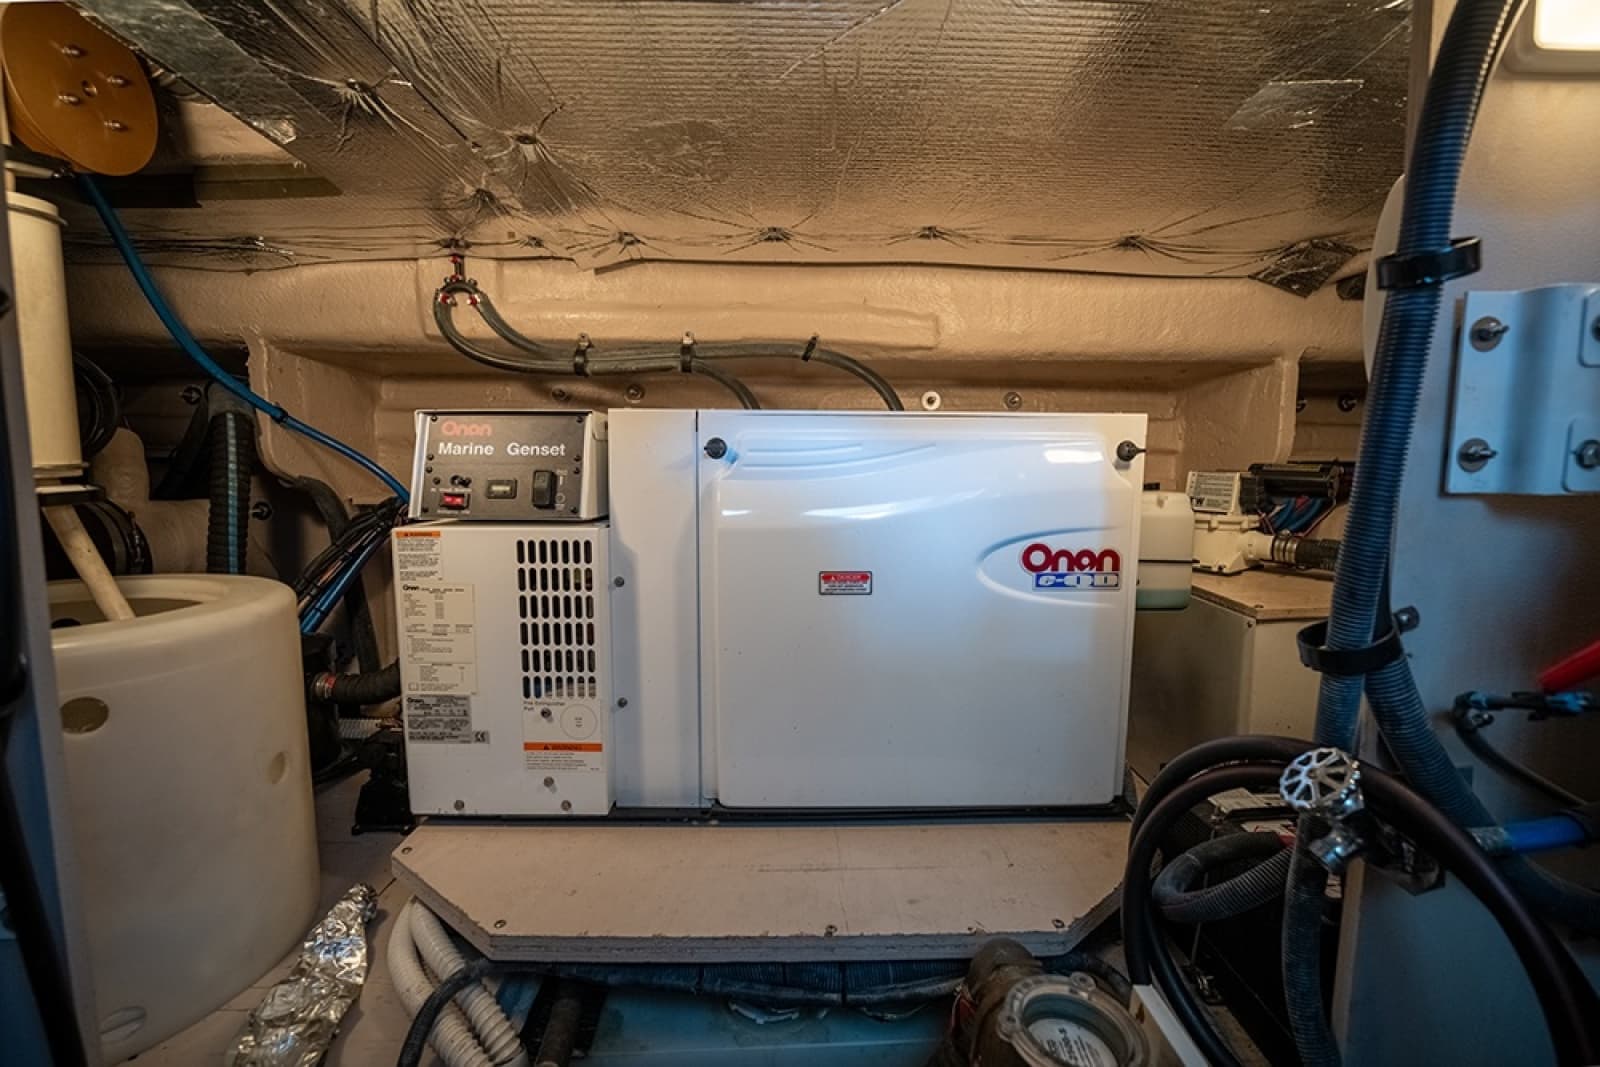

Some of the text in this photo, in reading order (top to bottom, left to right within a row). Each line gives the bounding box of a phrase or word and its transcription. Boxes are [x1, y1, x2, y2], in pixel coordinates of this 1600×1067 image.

[441, 420, 492, 436] Onan
[438, 442, 566, 456] Marine Genset
[1022, 543, 1120, 573] Onan
